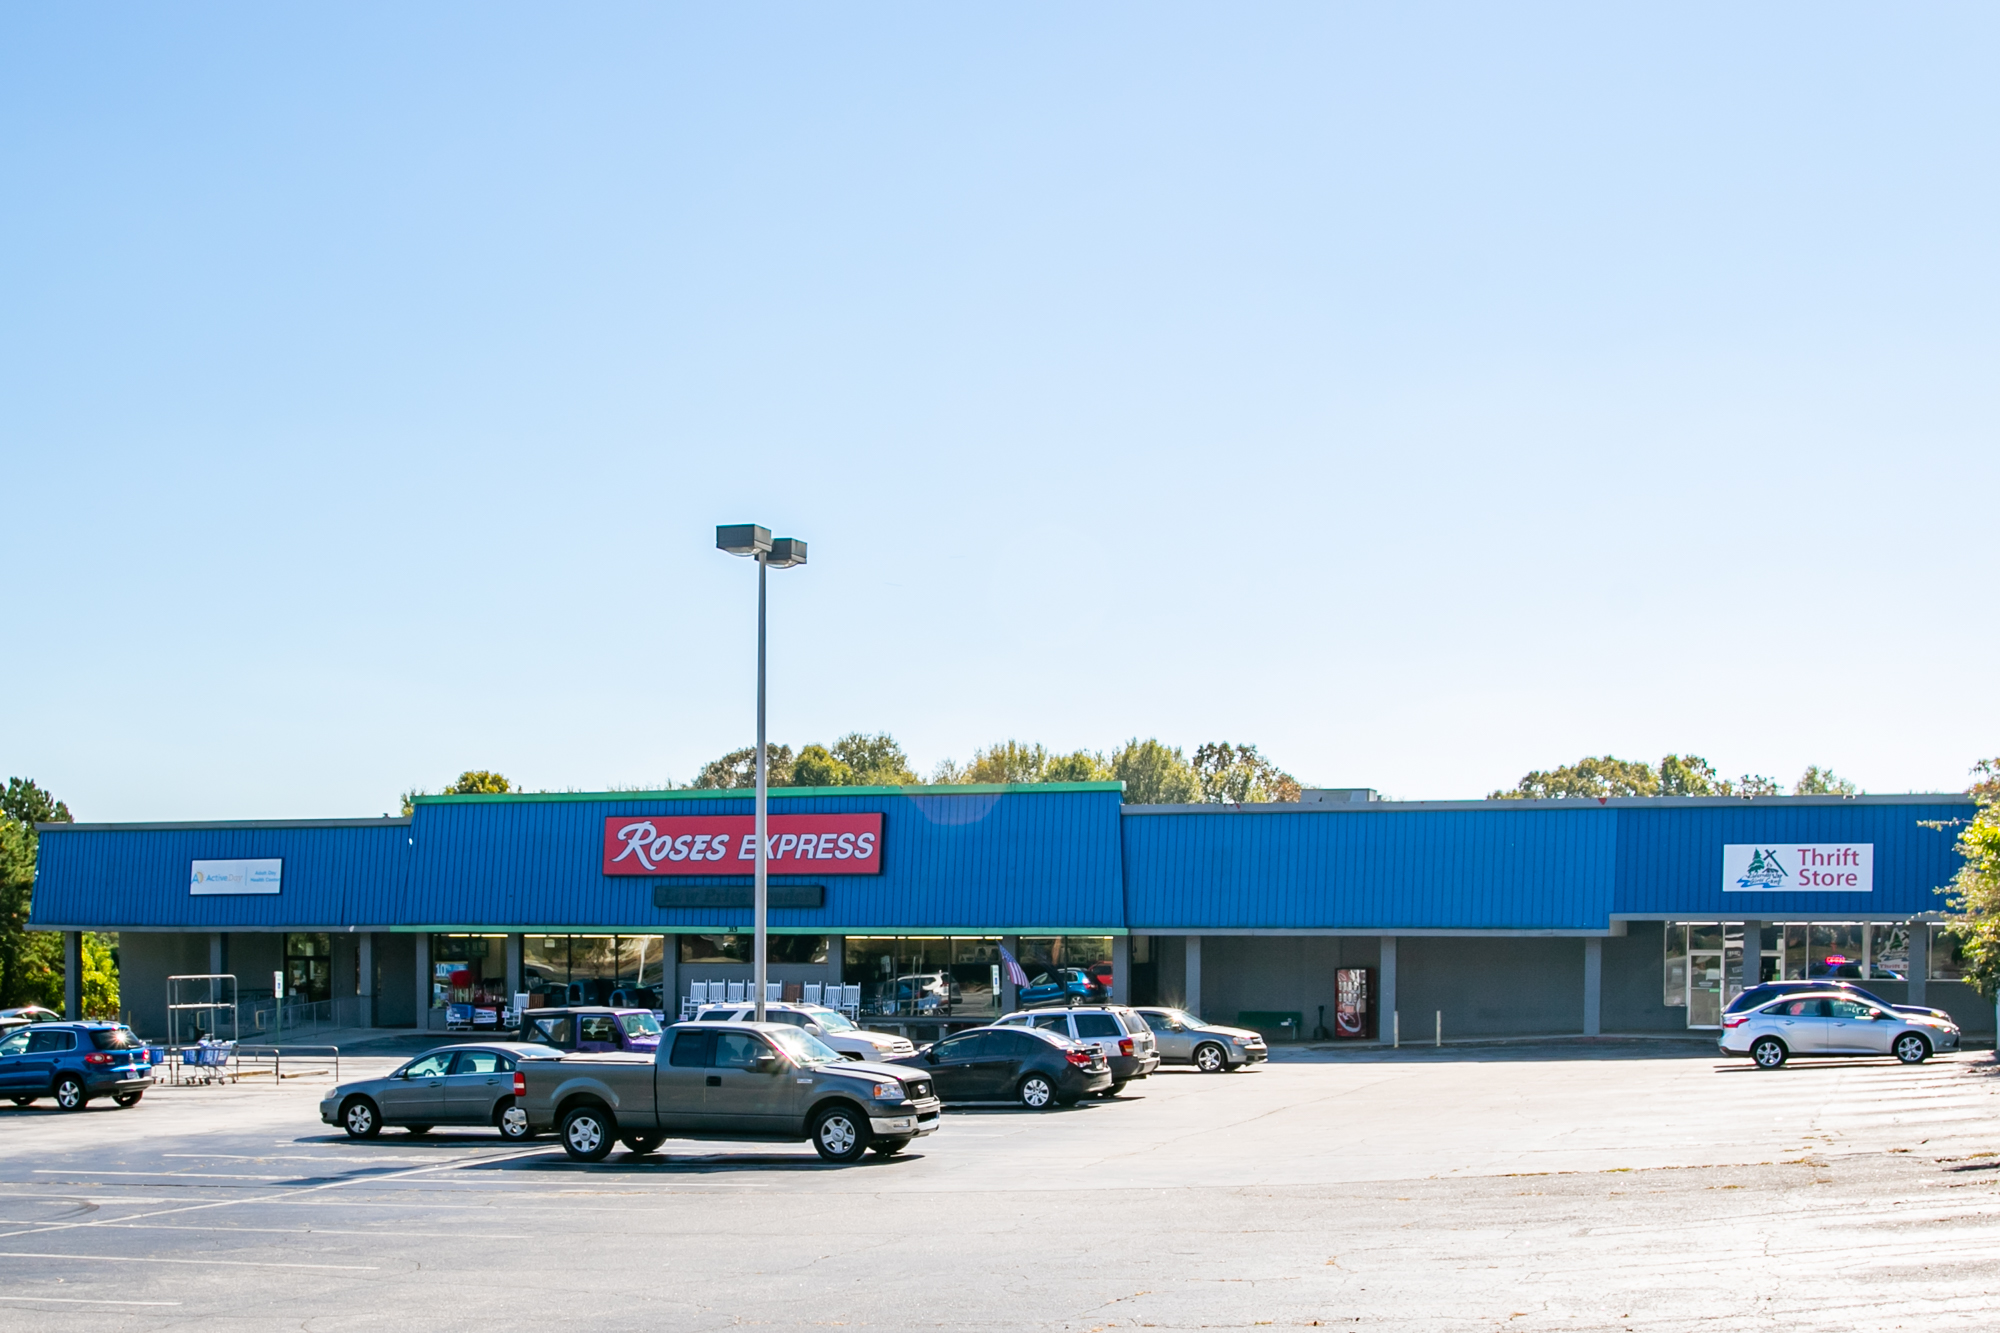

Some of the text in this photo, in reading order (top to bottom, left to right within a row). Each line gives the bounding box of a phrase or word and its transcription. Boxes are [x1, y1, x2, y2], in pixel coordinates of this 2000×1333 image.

[611, 821, 876, 871] ROSES EXPRESS
[1797, 848, 1860, 867] Thrift
[1798, 868, 1858, 886] Store
